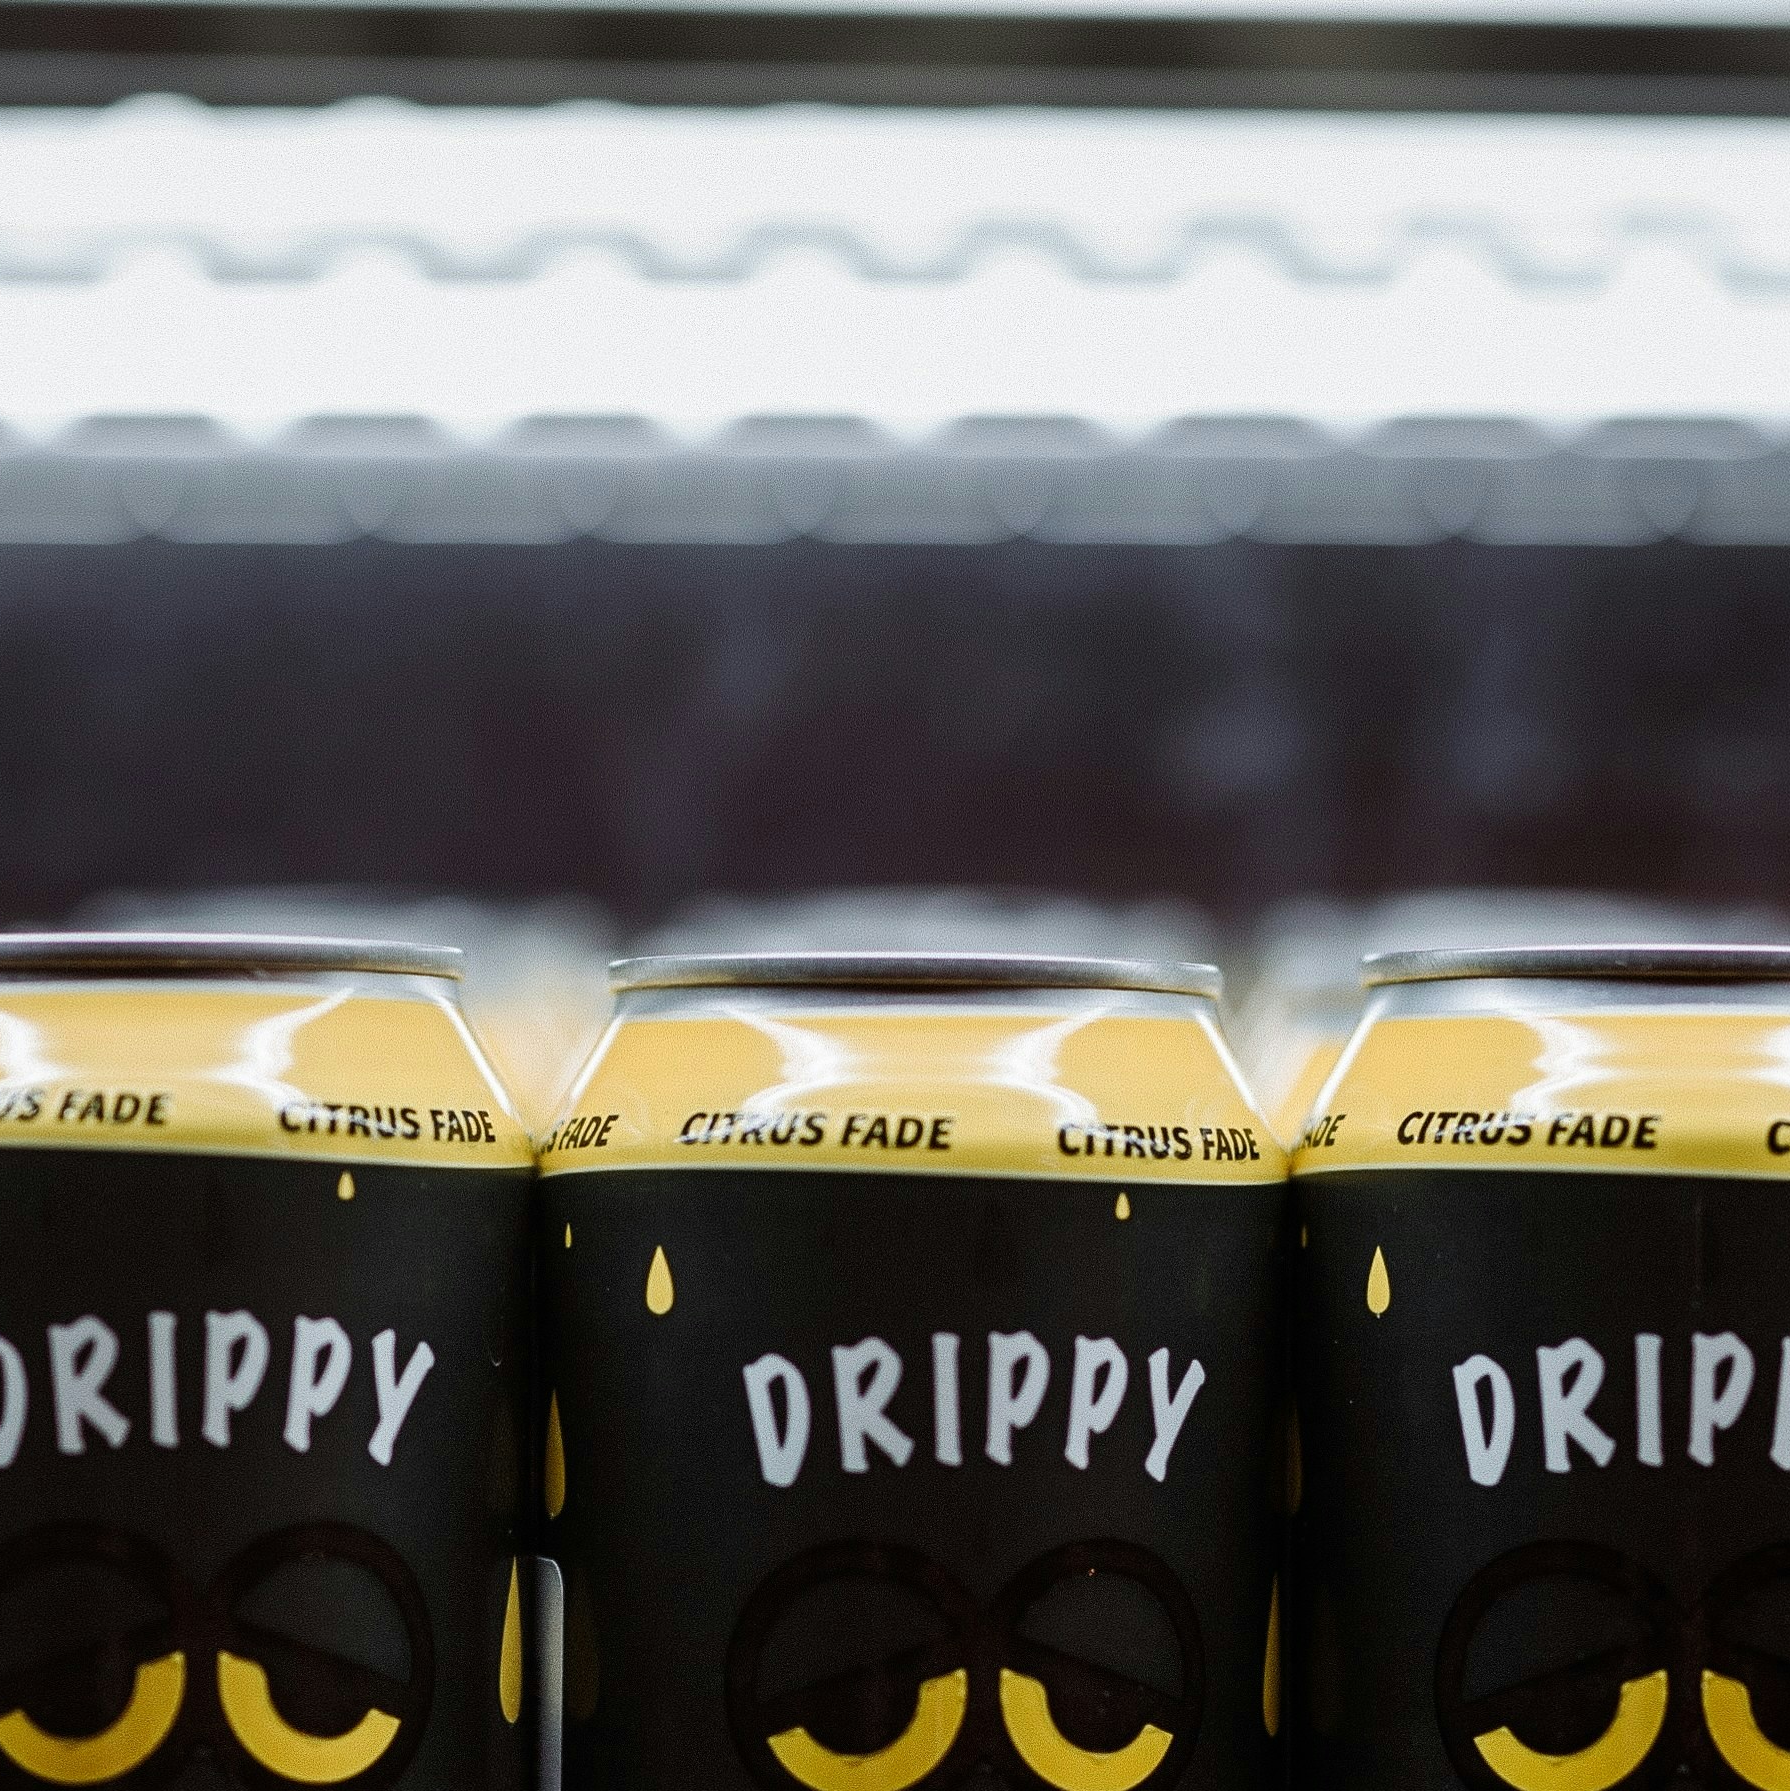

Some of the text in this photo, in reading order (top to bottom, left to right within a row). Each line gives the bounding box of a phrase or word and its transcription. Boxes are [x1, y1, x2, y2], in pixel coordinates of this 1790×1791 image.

[55, 1090, 172, 1128] FADE
[278, 1102, 421, 1141] CITRUS
[430, 1109, 497, 1144] FADE
[677, 1110, 955, 1152] CITRUS FADE
[1057, 1121, 1261, 1162] CITRUS FADE
[1395, 1110, 1661, 1150] CITRUS FADE
[742, 1330, 1207, 1488] DRIPPY
